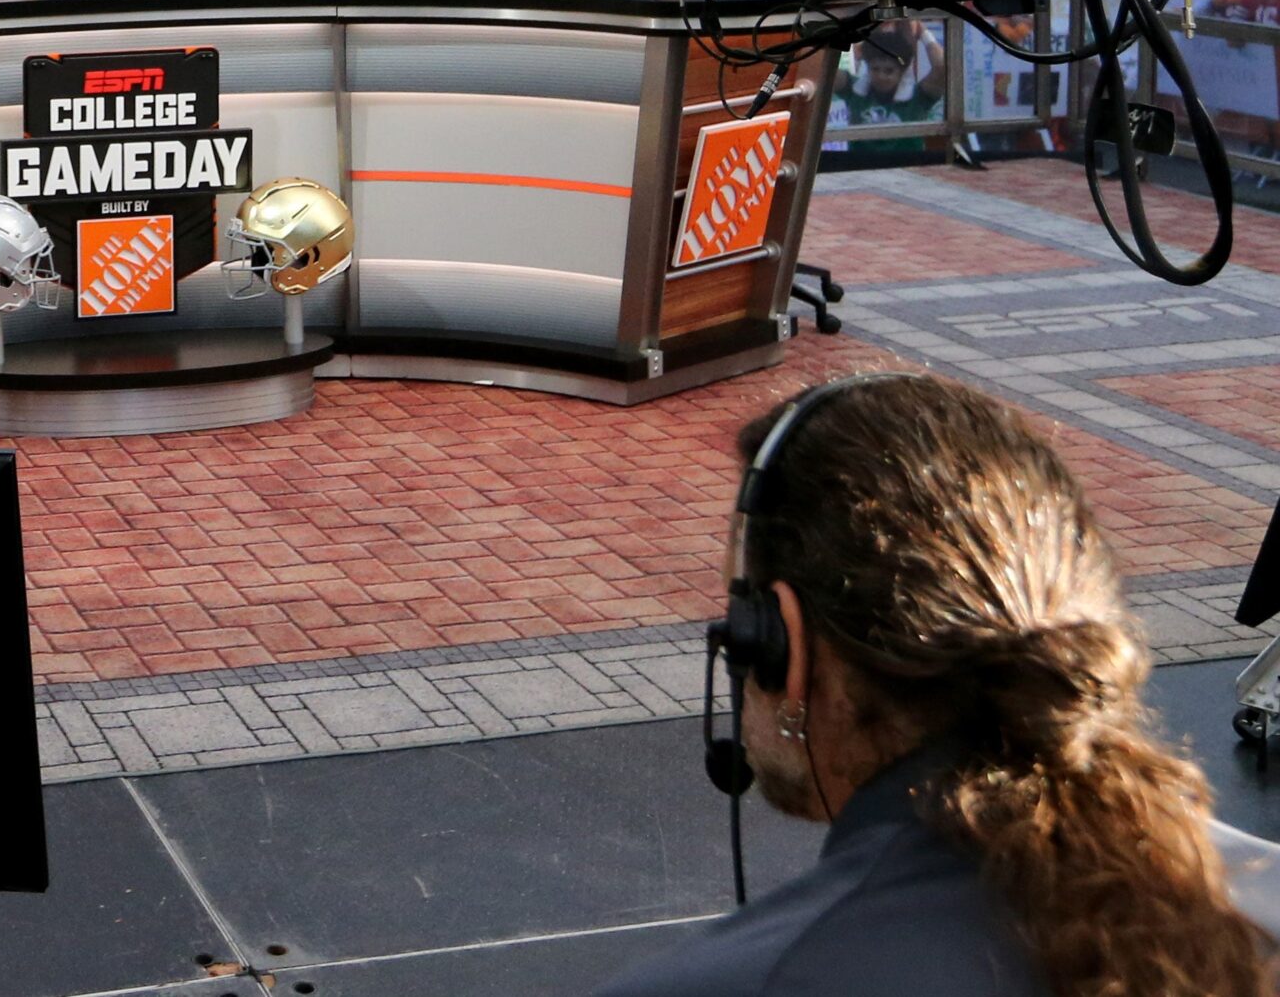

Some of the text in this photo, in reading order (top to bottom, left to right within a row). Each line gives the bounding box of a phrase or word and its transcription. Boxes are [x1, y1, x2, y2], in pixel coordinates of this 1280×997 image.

[83, 67, 165, 95] ESPN
[49, 92, 197, 132] COLLEGE
[6, 136, 248, 197] GAMEDAY
[683, 120, 786, 260] HOME
[705, 137, 744, 193] THE
[101, 200, 149, 214] BUILT BY
[715, 171, 777, 254] DEPOT
[80, 217, 172, 315] HOME
[91, 232, 127, 267] THE
[117, 256, 172, 313] DEPOT
